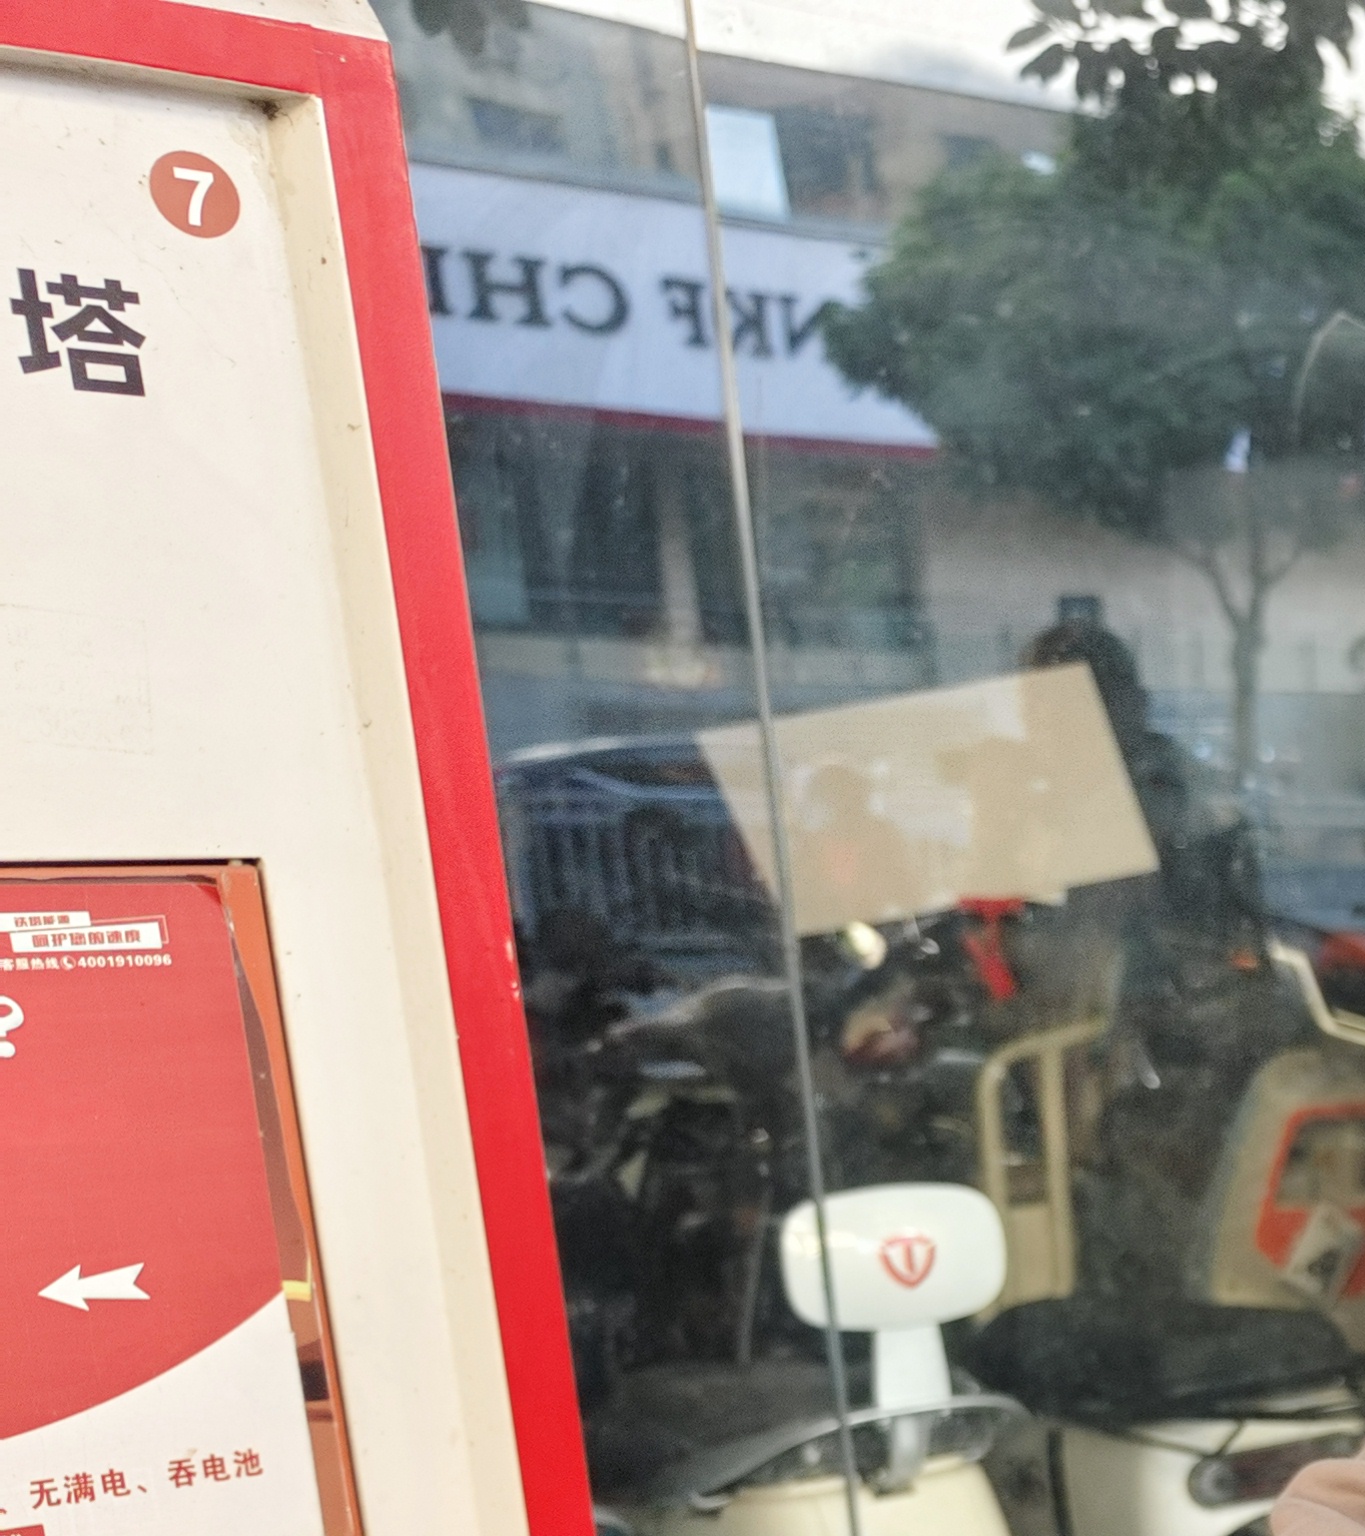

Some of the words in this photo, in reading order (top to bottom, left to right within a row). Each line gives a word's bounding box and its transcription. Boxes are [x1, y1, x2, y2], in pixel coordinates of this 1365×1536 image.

[171, 168, 214, 227] 7
[10, 267, 147, 397] 塔
[77, 953, 173, 968] 4001910096
